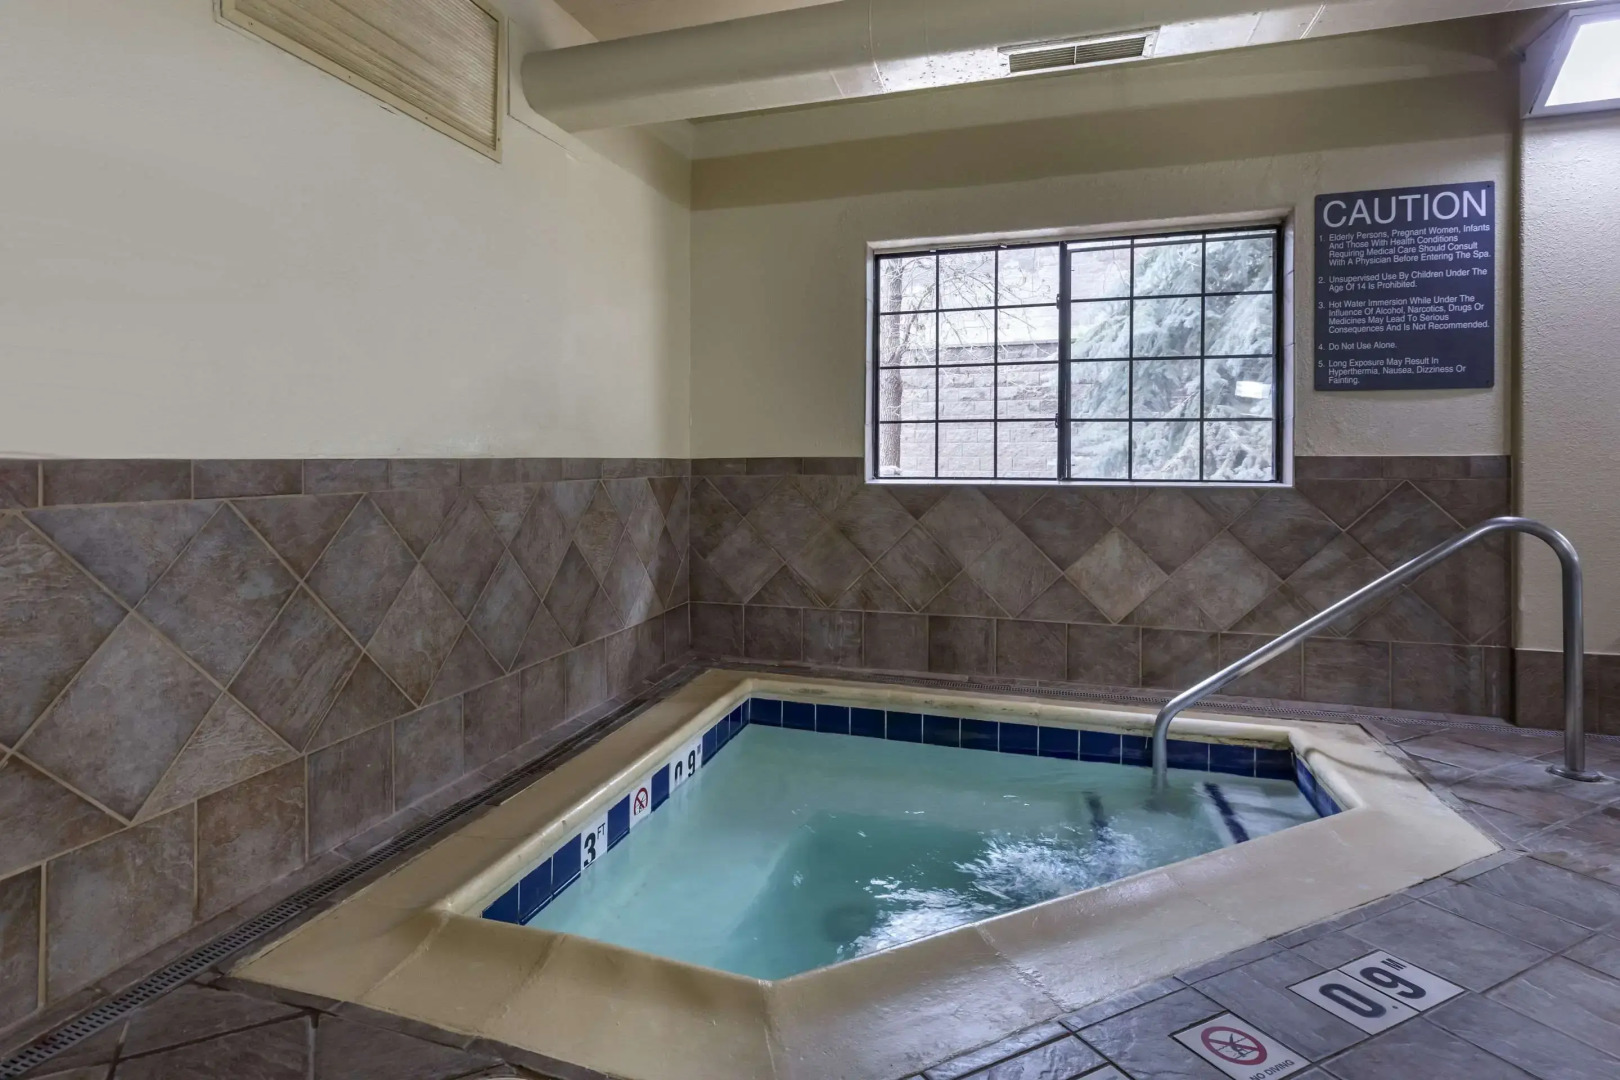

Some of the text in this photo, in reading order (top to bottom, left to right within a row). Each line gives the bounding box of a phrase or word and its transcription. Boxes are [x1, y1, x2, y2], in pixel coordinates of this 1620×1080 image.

[1323, 189, 1486, 227] CAUTION
[1357, 231, 1388, 239] Persons,
[1392, 228, 1426, 238] Pregnant
[1429, 226, 1460, 234] Women,
[1463, 224, 1490, 232] Infants
[1417, 235, 1458, 244] Conditions
[1329, 250, 1364, 259] Requiring
[1448, 242, 1477, 250] Consult
[1356, 257, 1391, 266] Physician
[1421, 253, 1453, 261] Entering
[1474, 250, 1490, 259] Spa.
[1329, 274, 1379, 283] Unsupervised
[1399, 272, 1409, 280] By
[1411, 270, 1443, 278] Children
[1329, 284, 1343, 292] Age
[1377, 280, 1417, 289] Prohibited.
[1368, 298, 1407, 306] Immersion
[1460, 294, 1475, 302] The
[1329, 309, 1362, 317] Influence
[1376, 306, 1405, 314] Alcohol,
[1408, 305, 1445, 313] Narcotics,
[1448, 304, 1472, 312] Drugs
[1329, 317, 1366, 325] Medicines
[1368, 316, 1384, 325] May
[1329, 325, 1383, 334] Consequences
[1428, 321, 1490, 330] Recommended.
[1328, 360, 1347, 368] Long
[1350, 359, 1384, 368] Exposure
[1387, 358, 1402, 366] May
[1405, 357, 1429, 365] Result
[1329, 368, 1380, 376] Hyperthermia,
[1417, 365, 1453, 373] Dizziness
[583, 823, 605, 867] 3 FT
[1264, 1059, 1295, 1076] DIVING
